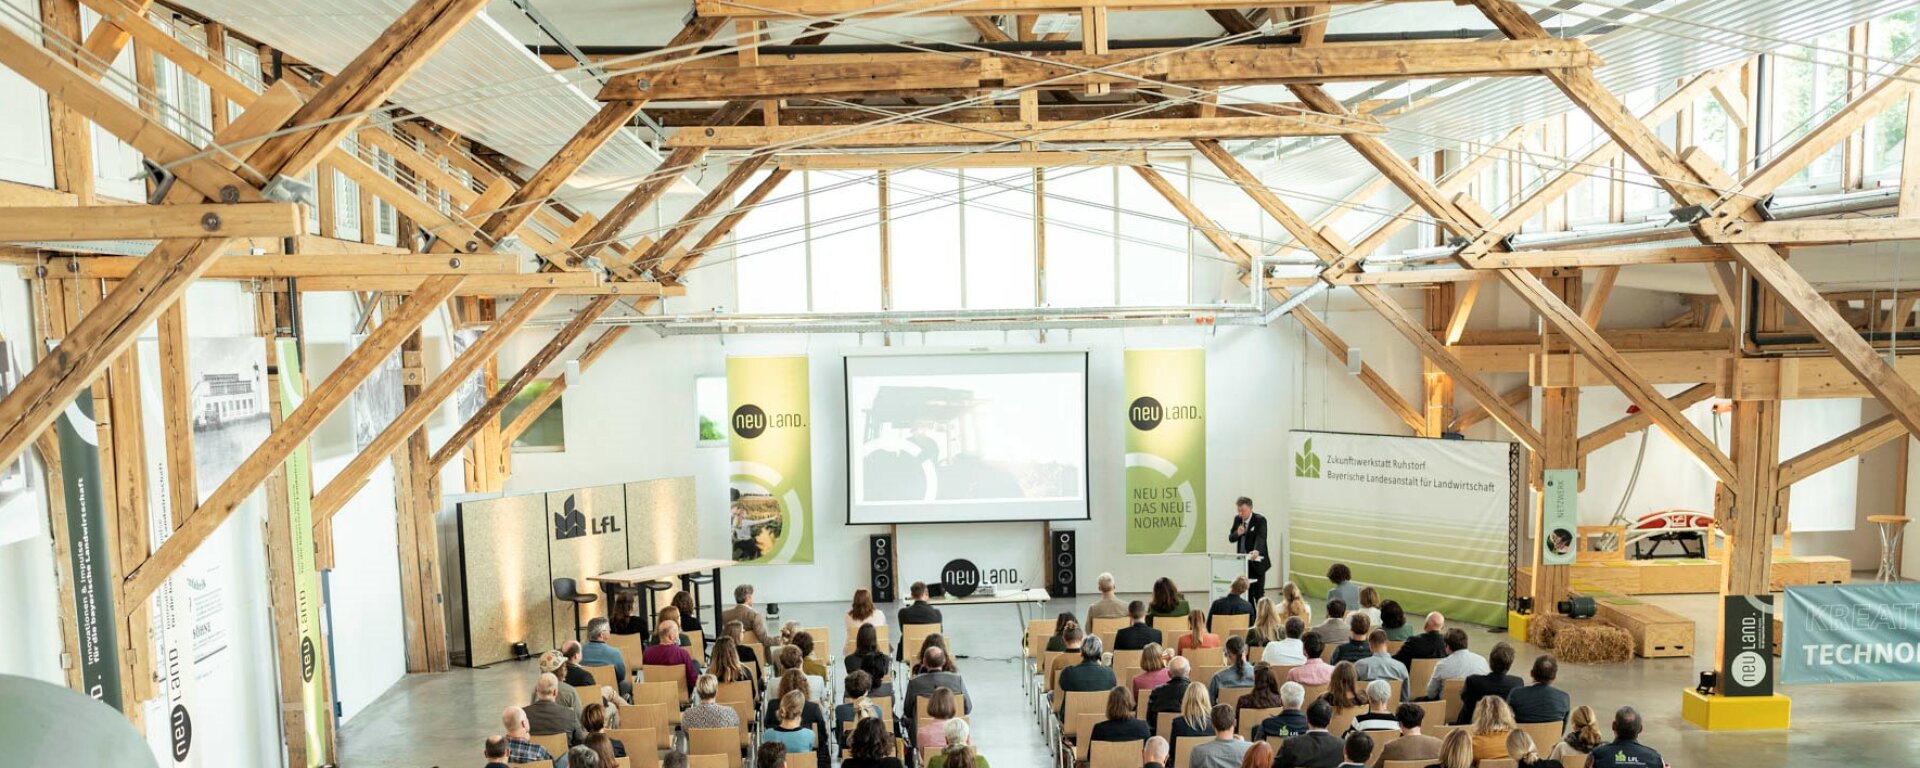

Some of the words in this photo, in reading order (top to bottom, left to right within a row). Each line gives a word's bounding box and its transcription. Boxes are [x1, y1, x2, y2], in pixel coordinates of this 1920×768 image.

[735, 413, 763, 429] neu
[1133, 406, 1160, 421] neu
[1393, 459, 1426, 470] Ruhstorf
[1327, 470, 1365, 481] Bayerische
[1366, 473, 1419, 487] Landesanstalt
[1420, 477, 1432, 487] für
[1433, 477, 1495, 492] Landwirtschaft
[1134, 487, 1157, 500] NEU
[1162, 487, 1179, 498] IST
[1557, 480, 1565, 518] NETZWERK
[1134, 502, 1157, 514] DAS
[1161, 501, 1192, 513] NEUE
[78, 478, 91, 562] Landwirtschaft
[591, 515, 621, 535] LfL
[1134, 517, 1187, 528] NORMAL.
[78, 541, 86, 583] Impulse
[945, 569, 975, 586] neu
[87, 564, 97, 625] bayerische
[82, 596, 94, 665] Innovationen
[91, 626, 99, 643] die
[92, 646, 100, 663] für
[303, 641, 311, 678] neu
[1742, 656, 1756, 682] neu
[173, 710, 187, 756] neu
